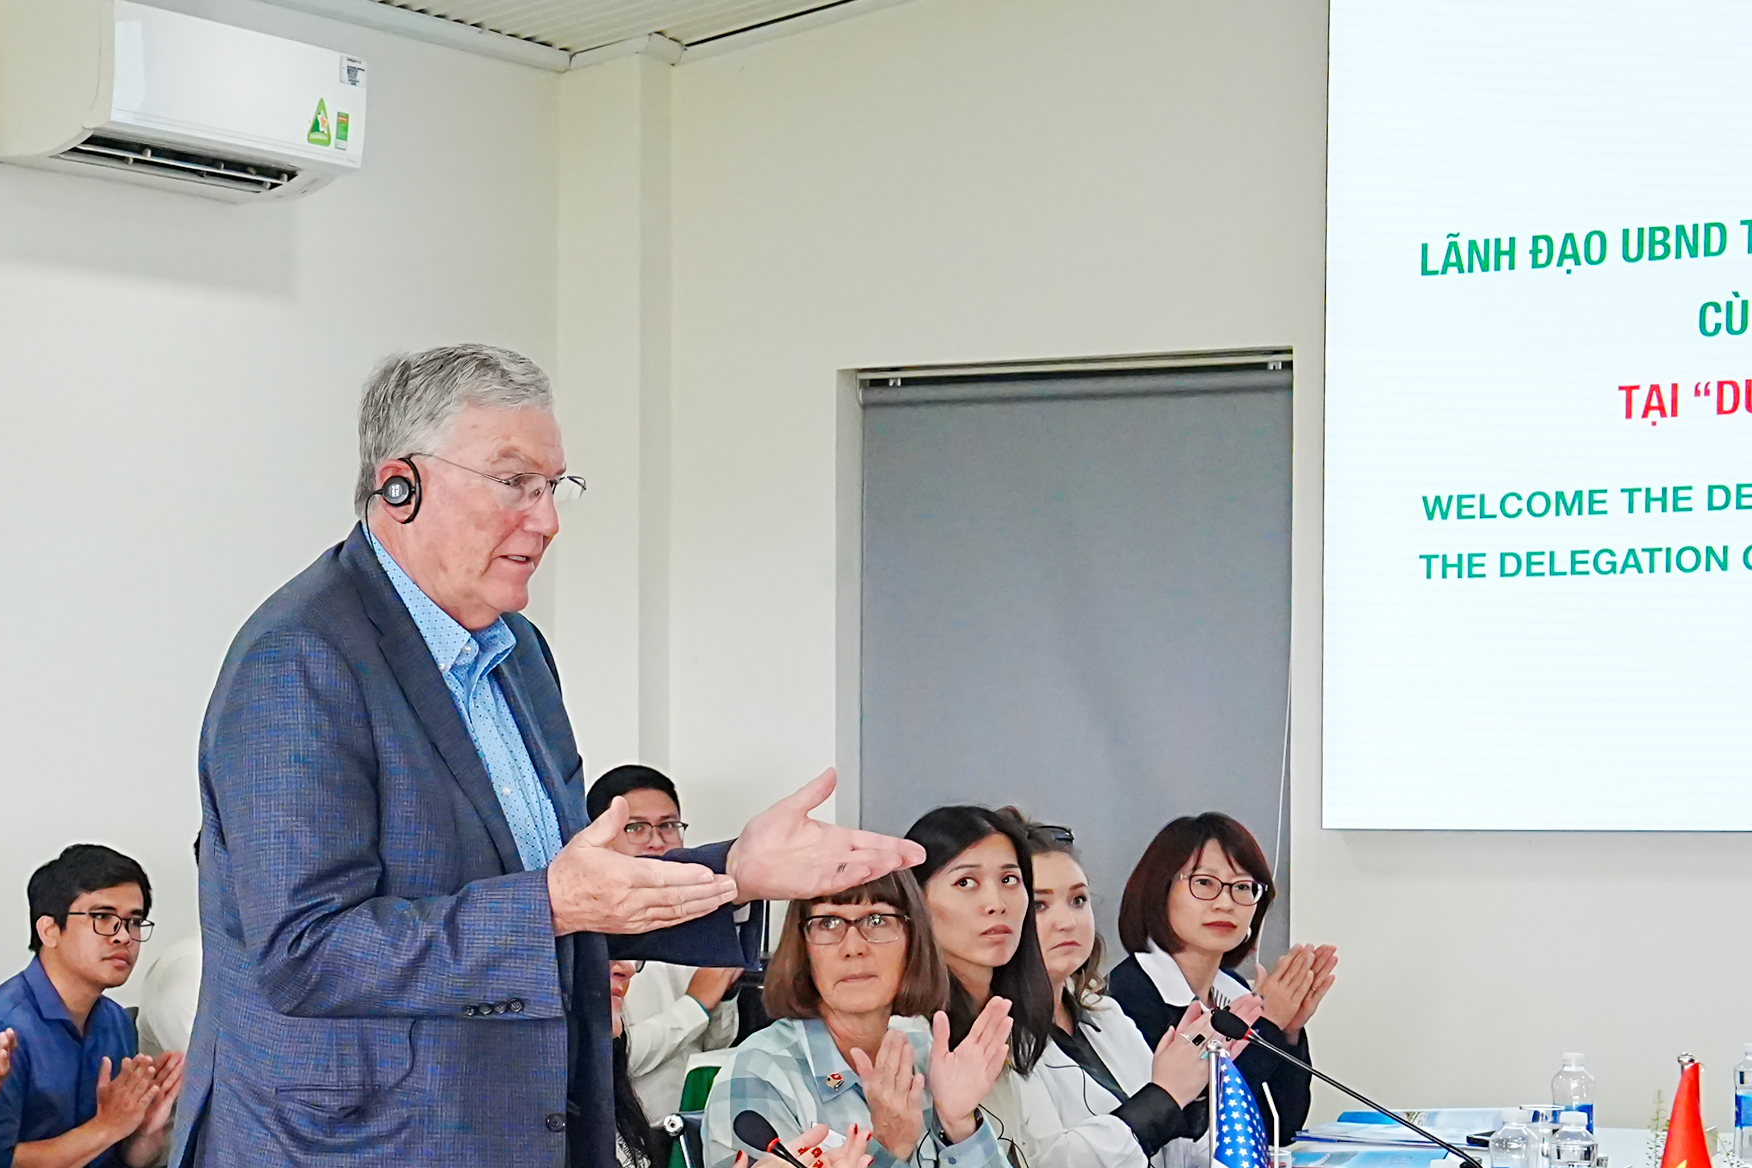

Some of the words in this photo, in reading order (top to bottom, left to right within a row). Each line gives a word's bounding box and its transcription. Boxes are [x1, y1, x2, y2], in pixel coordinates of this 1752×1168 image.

[1420, 232, 1516, 276] LÃNH
[1529, 230, 1607, 274] ĐẠO
[1622, 222, 1727, 263] UBND
[1699, 291, 1749, 337] CÙ
[1618, 382, 1678, 426] TẠI
[1422, 489, 1608, 521] WELCOME
[1620, 485, 1693, 514] THE
[1708, 483, 1752, 511] DE
[1419, 553, 1486, 580] THE
[1500, 545, 1729, 578] DELEGATION
